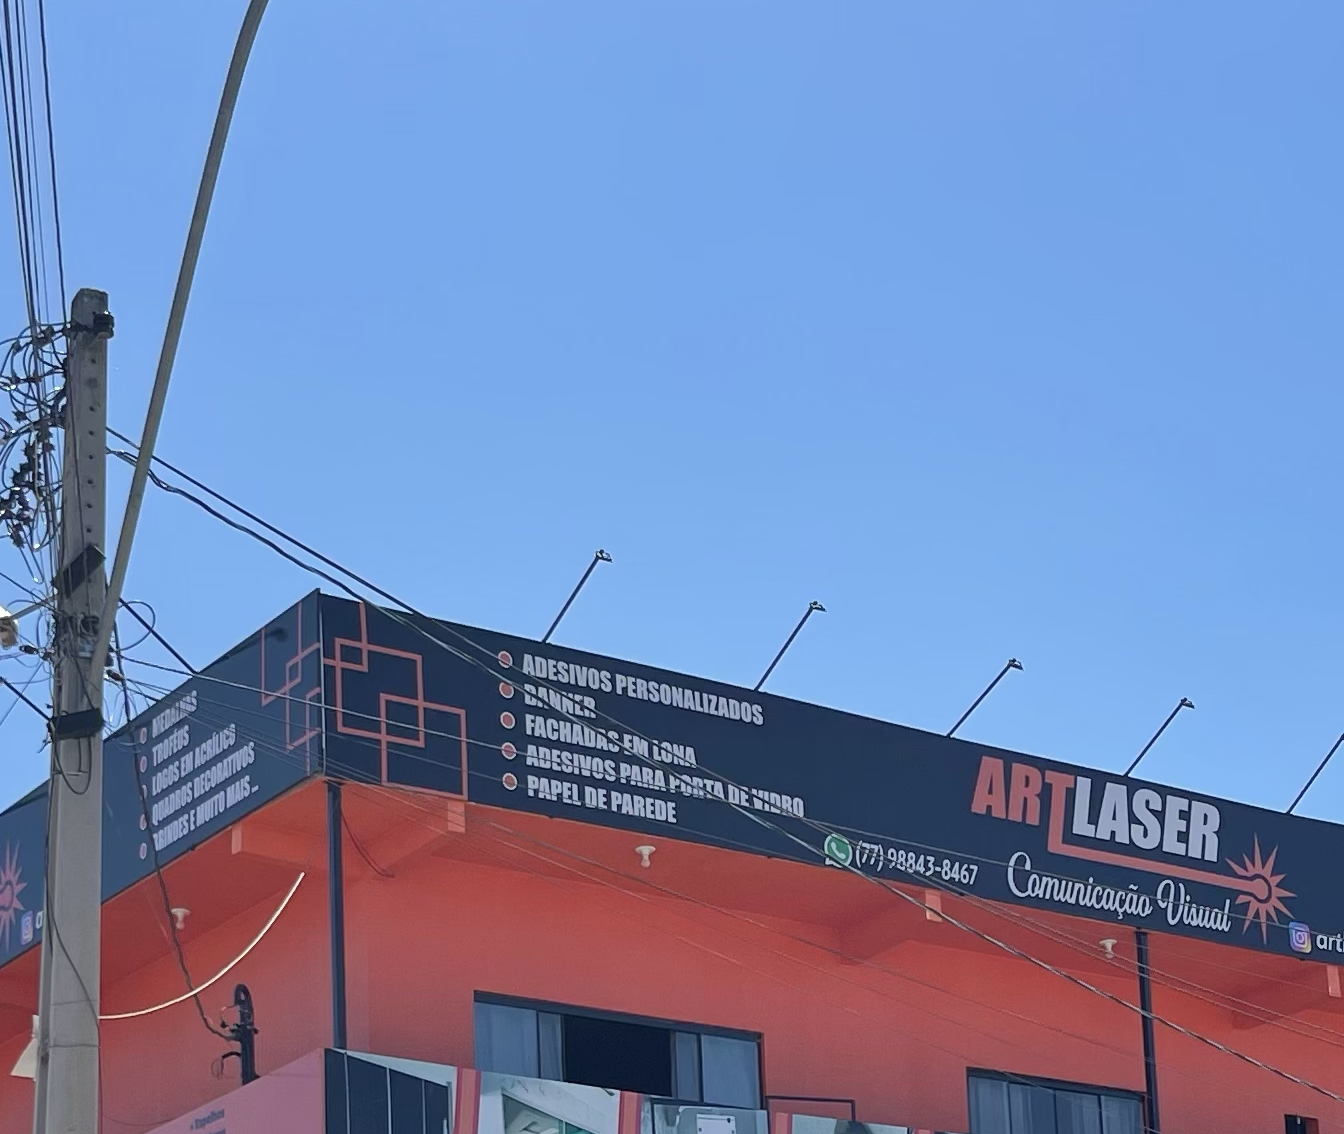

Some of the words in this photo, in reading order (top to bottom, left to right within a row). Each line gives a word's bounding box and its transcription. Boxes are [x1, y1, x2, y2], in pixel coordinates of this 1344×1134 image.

[522, 654, 612, 693] ADESIVOS
[615, 673, 764, 726] PERSONALIZADOS
[523, 683, 596, 718] BANNER
[152, 724, 189, 766] TROFÉUS
[152, 761, 180, 796] LOGOS
[180, 751, 194, 777] EM
[194, 723, 236, 769] ACRÍLICO
[525, 713, 620, 753] FACHADAS
[623, 733, 649, 758] EM
[652, 739, 697, 768] LONA
[152, 781, 192, 826] QUADROS
[194, 741, 255, 799] DECORATIVOS
[526, 744, 617, 782] ADESIVOS
[619, 762, 668, 792] PARA
[669, 774, 725, 802] PORTA
[728, 784, 750, 808] DE
[752, 788, 805, 818] VIDRO
[527, 775, 581, 807] PAPEL
[584, 786, 608, 809] DE
[611, 790, 677, 824] PAREDE
[190, 809, 196, 831] E
[196, 790, 225, 827] MUITO
[856, 840, 884, 872] (77)
[887, 847, 979, 886] 98843-8467
[1007, 850, 1153, 919] Comunicação
[1156, 878, 1232, 933] Visual
